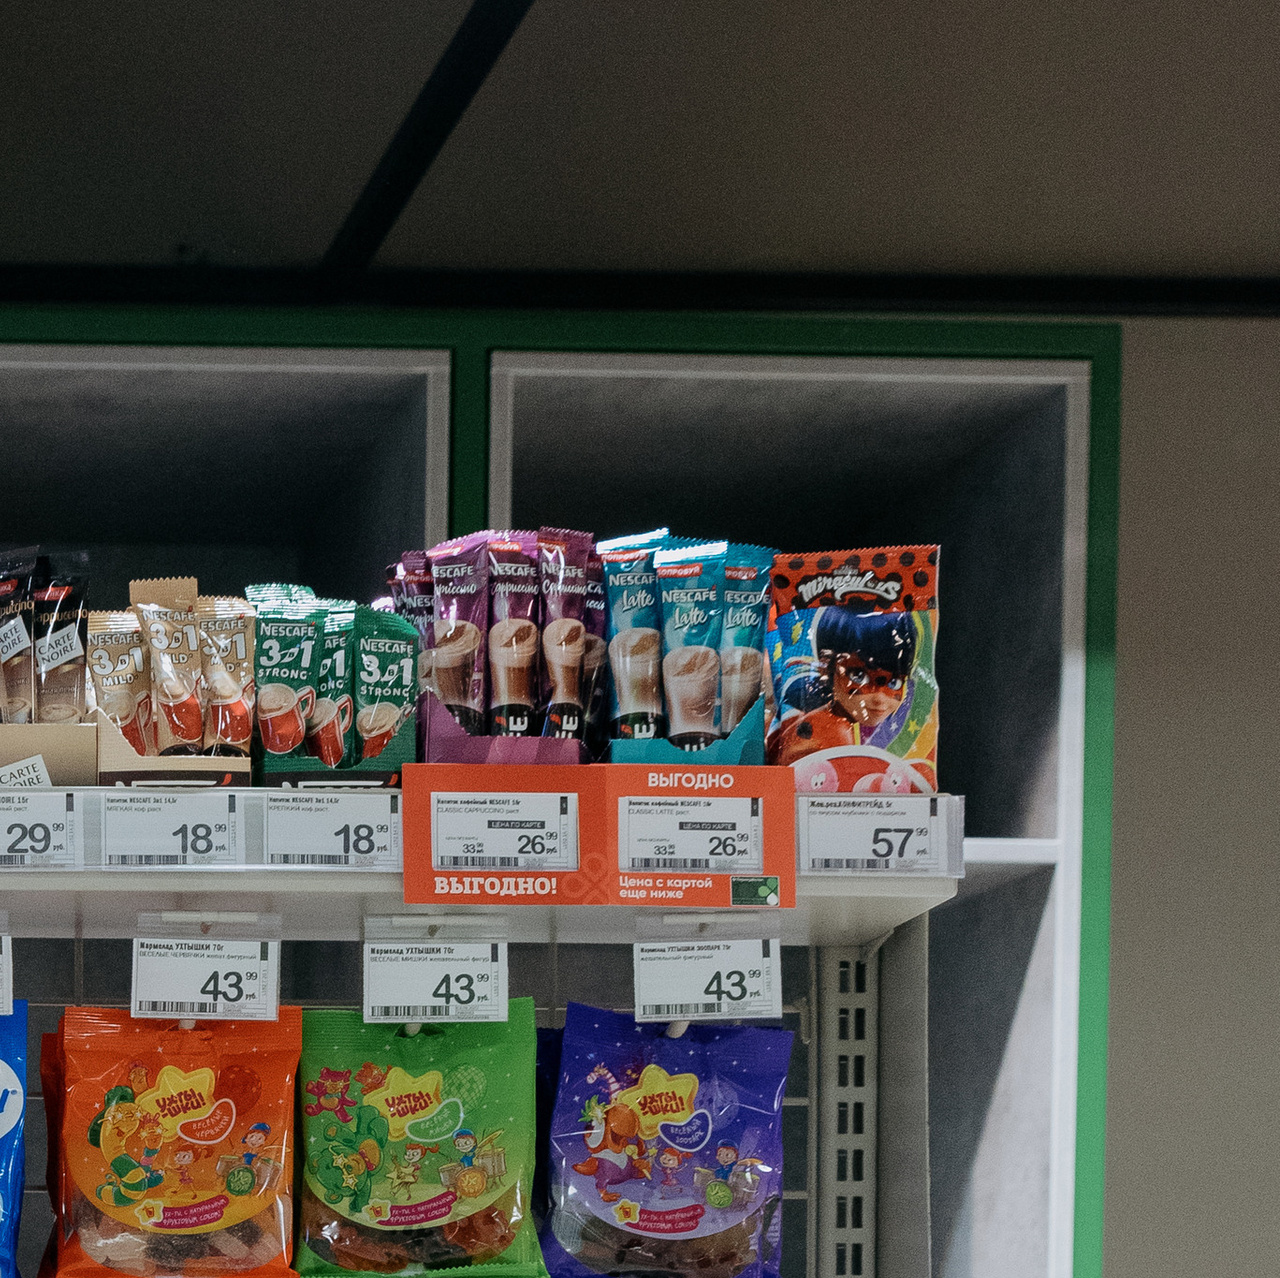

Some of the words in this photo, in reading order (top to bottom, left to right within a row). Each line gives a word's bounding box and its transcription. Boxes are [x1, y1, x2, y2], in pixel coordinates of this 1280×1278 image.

[258, 669, 308, 680] STRONG
[647, 772, 735, 790] ВЫГОДНО
[6, 823, 51, 854] 29
[172, 823, 214, 855] 18
[334, 823, 375, 855] 18
[517, 834, 546, 855] 26
[708, 835, 736, 856] 26
[871, 828, 914, 858] 57
[434, 876, 558, 895] ВЫГОДНО!
[200, 971, 244, 1003] 43
[431, 973, 475, 1005] 43
[703, 970, 748, 1002] 43
